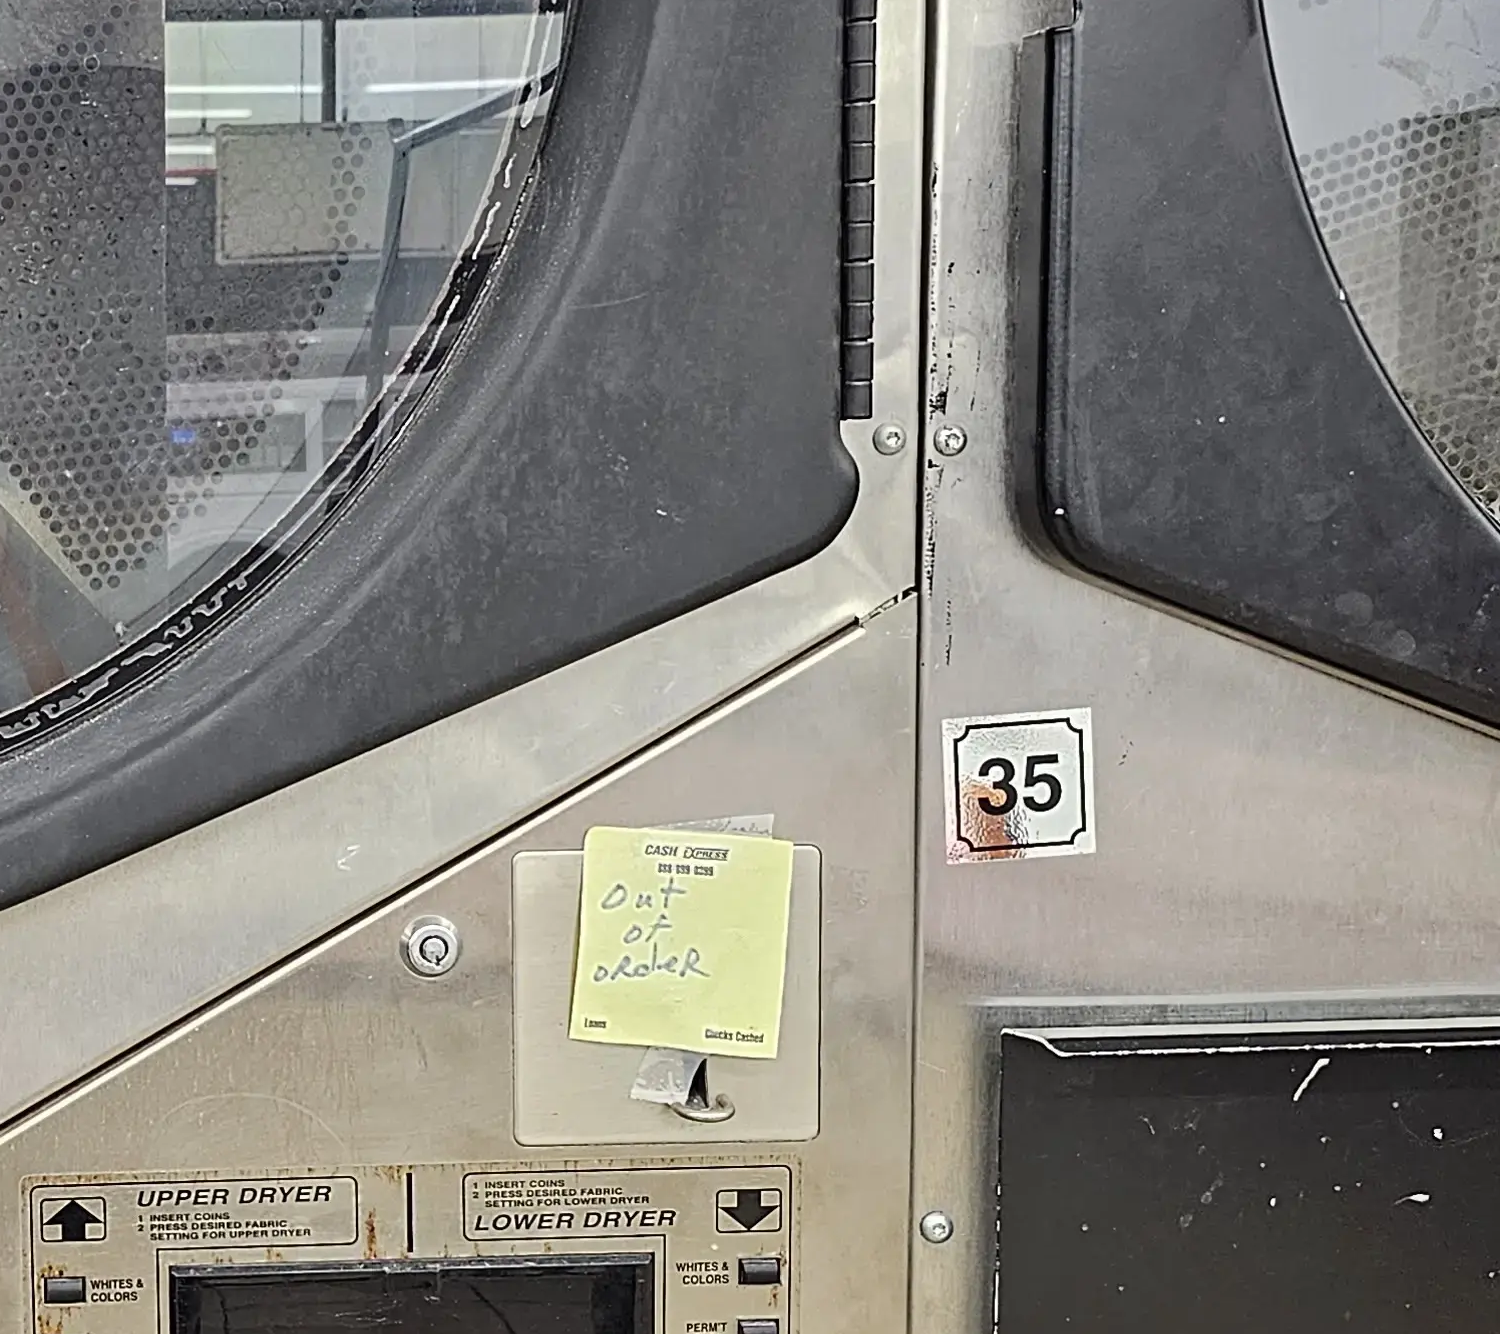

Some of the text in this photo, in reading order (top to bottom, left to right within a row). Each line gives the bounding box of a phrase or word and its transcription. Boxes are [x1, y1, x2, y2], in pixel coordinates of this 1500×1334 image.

[978, 753, 1062, 816] 35
[644, 844, 678, 857] CASH
[601, 876, 687, 909] Out
[623, 914, 673, 944] of
[484, 1180, 526, 1189] INSERT
[529, 1179, 565, 1187] COINS
[137, 1185, 332, 1207] UPPER DRYER
[472, 1187, 623, 1199] 2 PRESS DESIRED FABRIC
[485, 1196, 650, 1208] SETTING FOR LOWER DRYER
[138, 1212, 230, 1222] 1 INSERT COINS
[474, 1209, 677, 1231] LOWER DRYER
[137, 1220, 288, 1232] 2 PRESS DESIRED FABRIC
[150, 1228, 311, 1241] SETTING FOR UPPER DRYER
[676, 1261, 729, 1272] WHITES &
[90, 1278, 144, 1290] WHITES &
[682, 1274, 729, 1285] COLORS
[91, 1291, 138, 1303] COLORS
[686, 1322, 728, 1333] PERM'T
